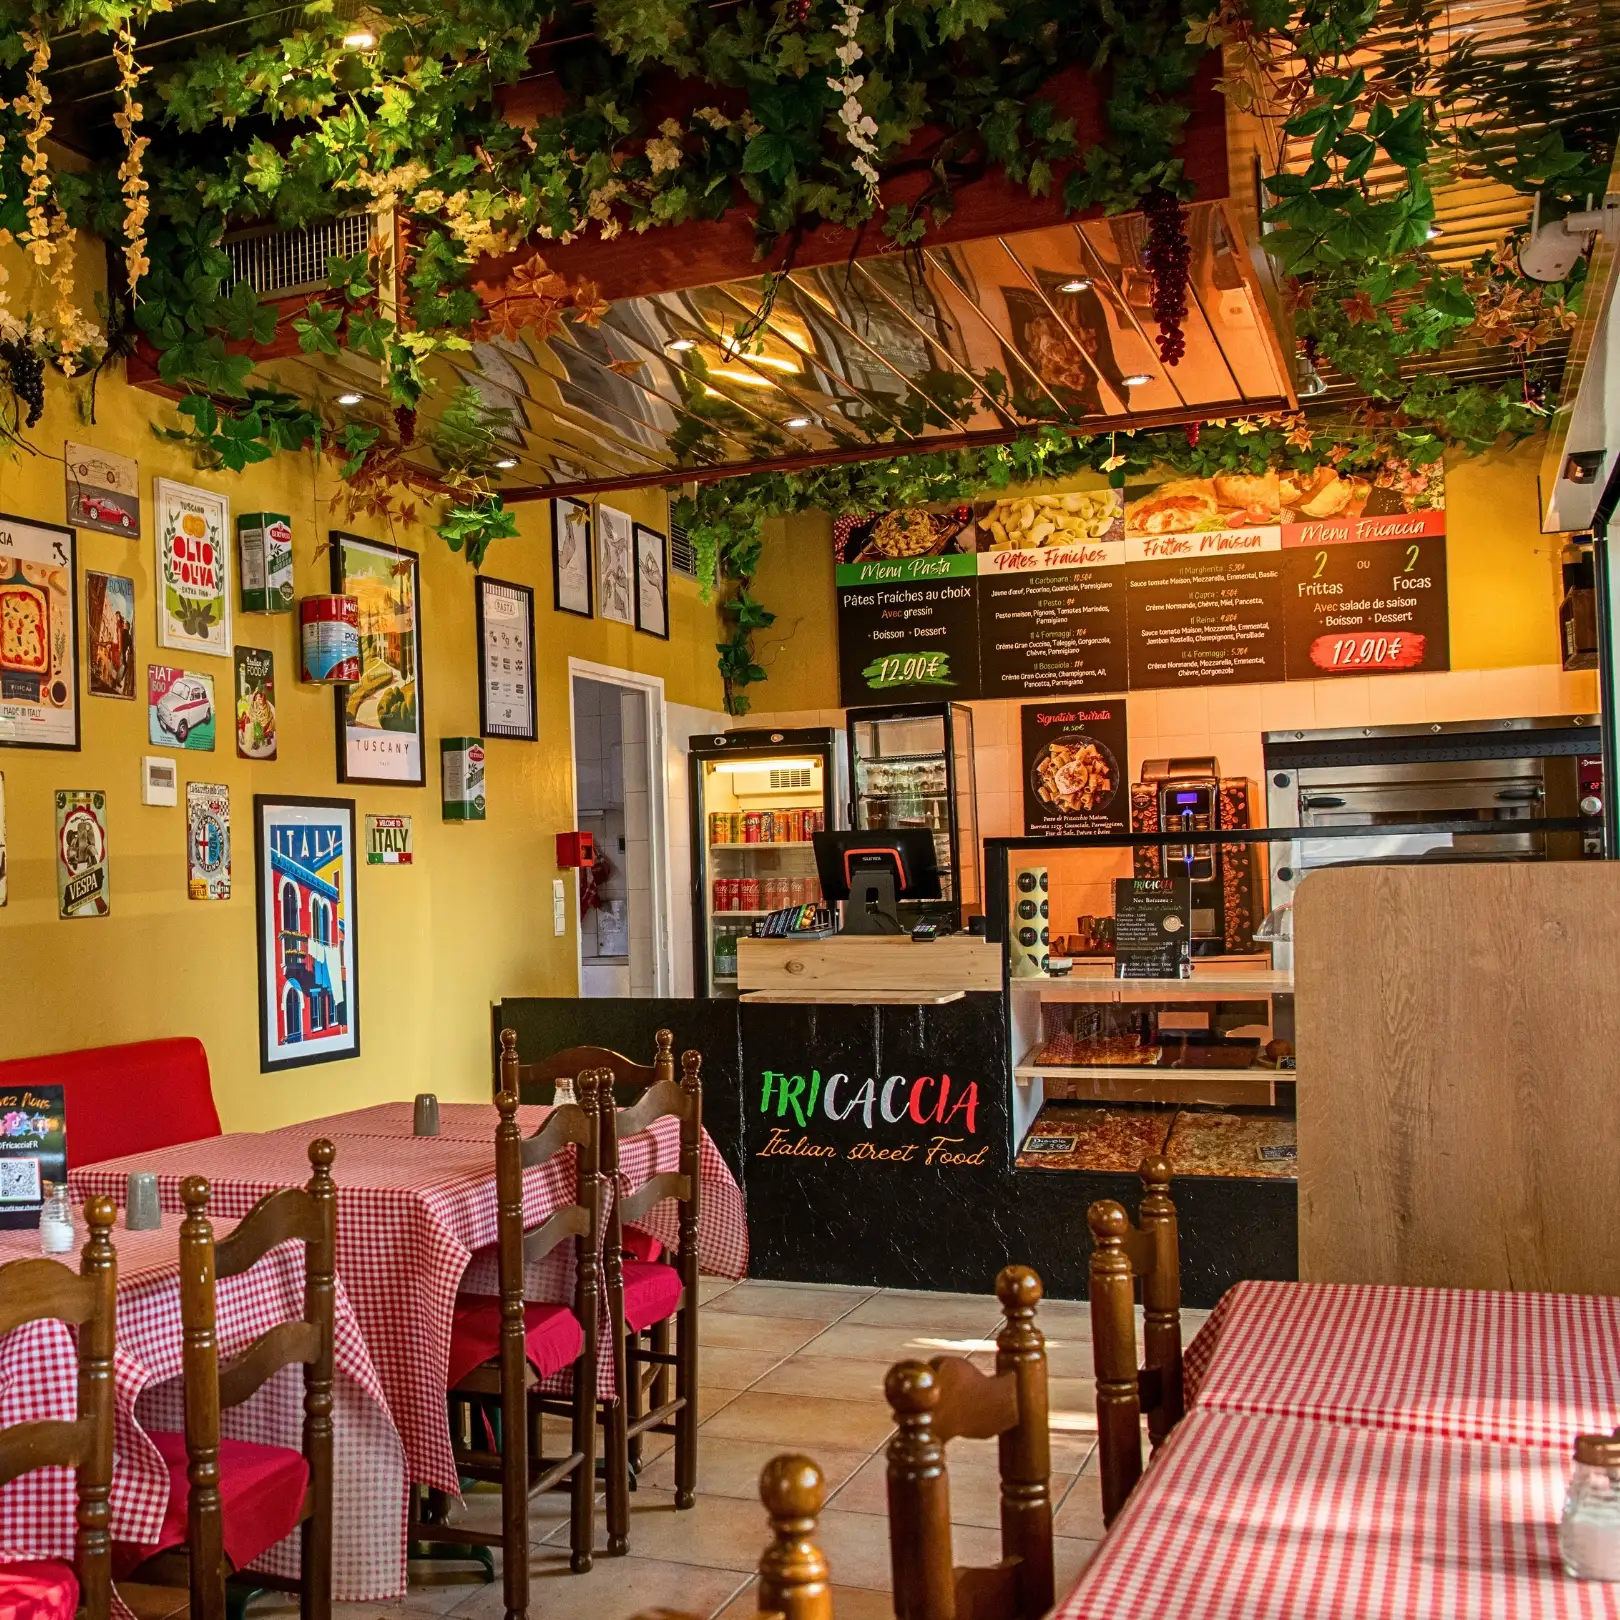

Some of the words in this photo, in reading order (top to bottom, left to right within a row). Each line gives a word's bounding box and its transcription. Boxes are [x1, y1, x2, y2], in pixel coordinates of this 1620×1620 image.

[181, 501, 205, 515] TUSCANO
[1300, 523, 1349, 543] Menu
[1355, 519, 1425, 539] Fricaccia
[173, 535, 214, 566] OLIO
[1142, 537, 1194, 557] Frittas
[1200, 533, 1262, 552] Maison
[993, 551, 1040, 571] Pâtes
[1044, 546, 1108, 566] Fraiches
[1312, 551, 1328, 579] 2
[1357, 560, 1371, 569] ou
[1403, 544, 1420, 573] 2
[860, 562, 902, 580] Menu
[907, 558, 951, 577] Pasta
[1184, 566, 1223, 576] Margherita
[1034, 576, 1069, 585] Carbonara
[1129, 580, 1147, 588] Sauce
[1192, 575, 1226, 583] Mozzarella,
[1226, 572, 1258, 581] Emmental,
[1298, 582, 1344, 597] Frittas
[1392, 576, 1432, 591] Focas
[108, 579, 133, 596] ROME
[1025, 586, 1052, 594] Pecorino,
[1080, 581, 1113, 591] Parmigiano
[843, 594, 875, 608] Pâtes
[877, 589, 924, 605] Fraiches
[925, 590, 939, 601] au
[940, 585, 971, 599] choix
[1194, 591, 1216, 600] Capra
[496, 601, 513, 612] PASTA
[1043, 599, 1062, 607] Pesto
[1145, 604, 1165, 612] Crème
[1313, 602, 1338, 613] Avec
[1339, 599, 1371, 611] salade
[1372, 598, 1385, 609] de
[1386, 597, 1417, 608] saison
[881, 609, 902, 619] Avec
[903, 606, 933, 619] gressin
[1325, 615, 1363, 627] Boisson
[1374, 612, 1413, 624] Dessert
[1036, 617, 1068, 625] Parmigiano
[1196, 616, 1215, 624] Reina
[873, 629, 905, 640] Boisson
[914, 626, 947, 637] Dessert
[1041, 630, 1072, 639] Formaggi
[1141, 629, 1158, 637] Sauce
[1204, 624, 1238, 633] Mozzarella,
[1238, 622, 1270, 631] Emmental,
[1146, 637, 1169, 646] Jambon
[1048, 647, 1080, 656] Parmigiano
[1193, 648, 1227, 658] Formaggi
[1333, 637, 1404, 665] 12.90€
[1039, 662, 1070, 670] Boscaiola
[1200, 659, 1233, 667] Mozzarella,
[1233, 656, 1265, 665] Emmental,
[148, 665, 174, 682] FIAT
[246, 665, 262, 677] FOOD
[880, 656, 939, 682] 12.90€
[1200, 667, 1234, 676] Gorgonzola
[1051, 679, 1084, 688] Parmigiano
[3, 706, 20, 716] MADE
[27, 708, 42, 718] ITALY
[1036, 713, 1076, 726] Signature
[1077, 710, 1111, 721] Burrata
[356, 739, 409, 754] TUSCANY
[378, 819, 395, 827] WELCOME
[276, 829, 337, 858] ITALY
[371, 827, 409, 853] ITALY
[69, 872, 98, 900] VESPA
[1133, 880, 1173, 891] FRICACCIA
[760, 1069, 980, 1134] FRICACCIA
[755, 1127, 837, 1159] Italian
[846, 1140, 921, 1162] street
[923, 1135, 990, 1166] Food
